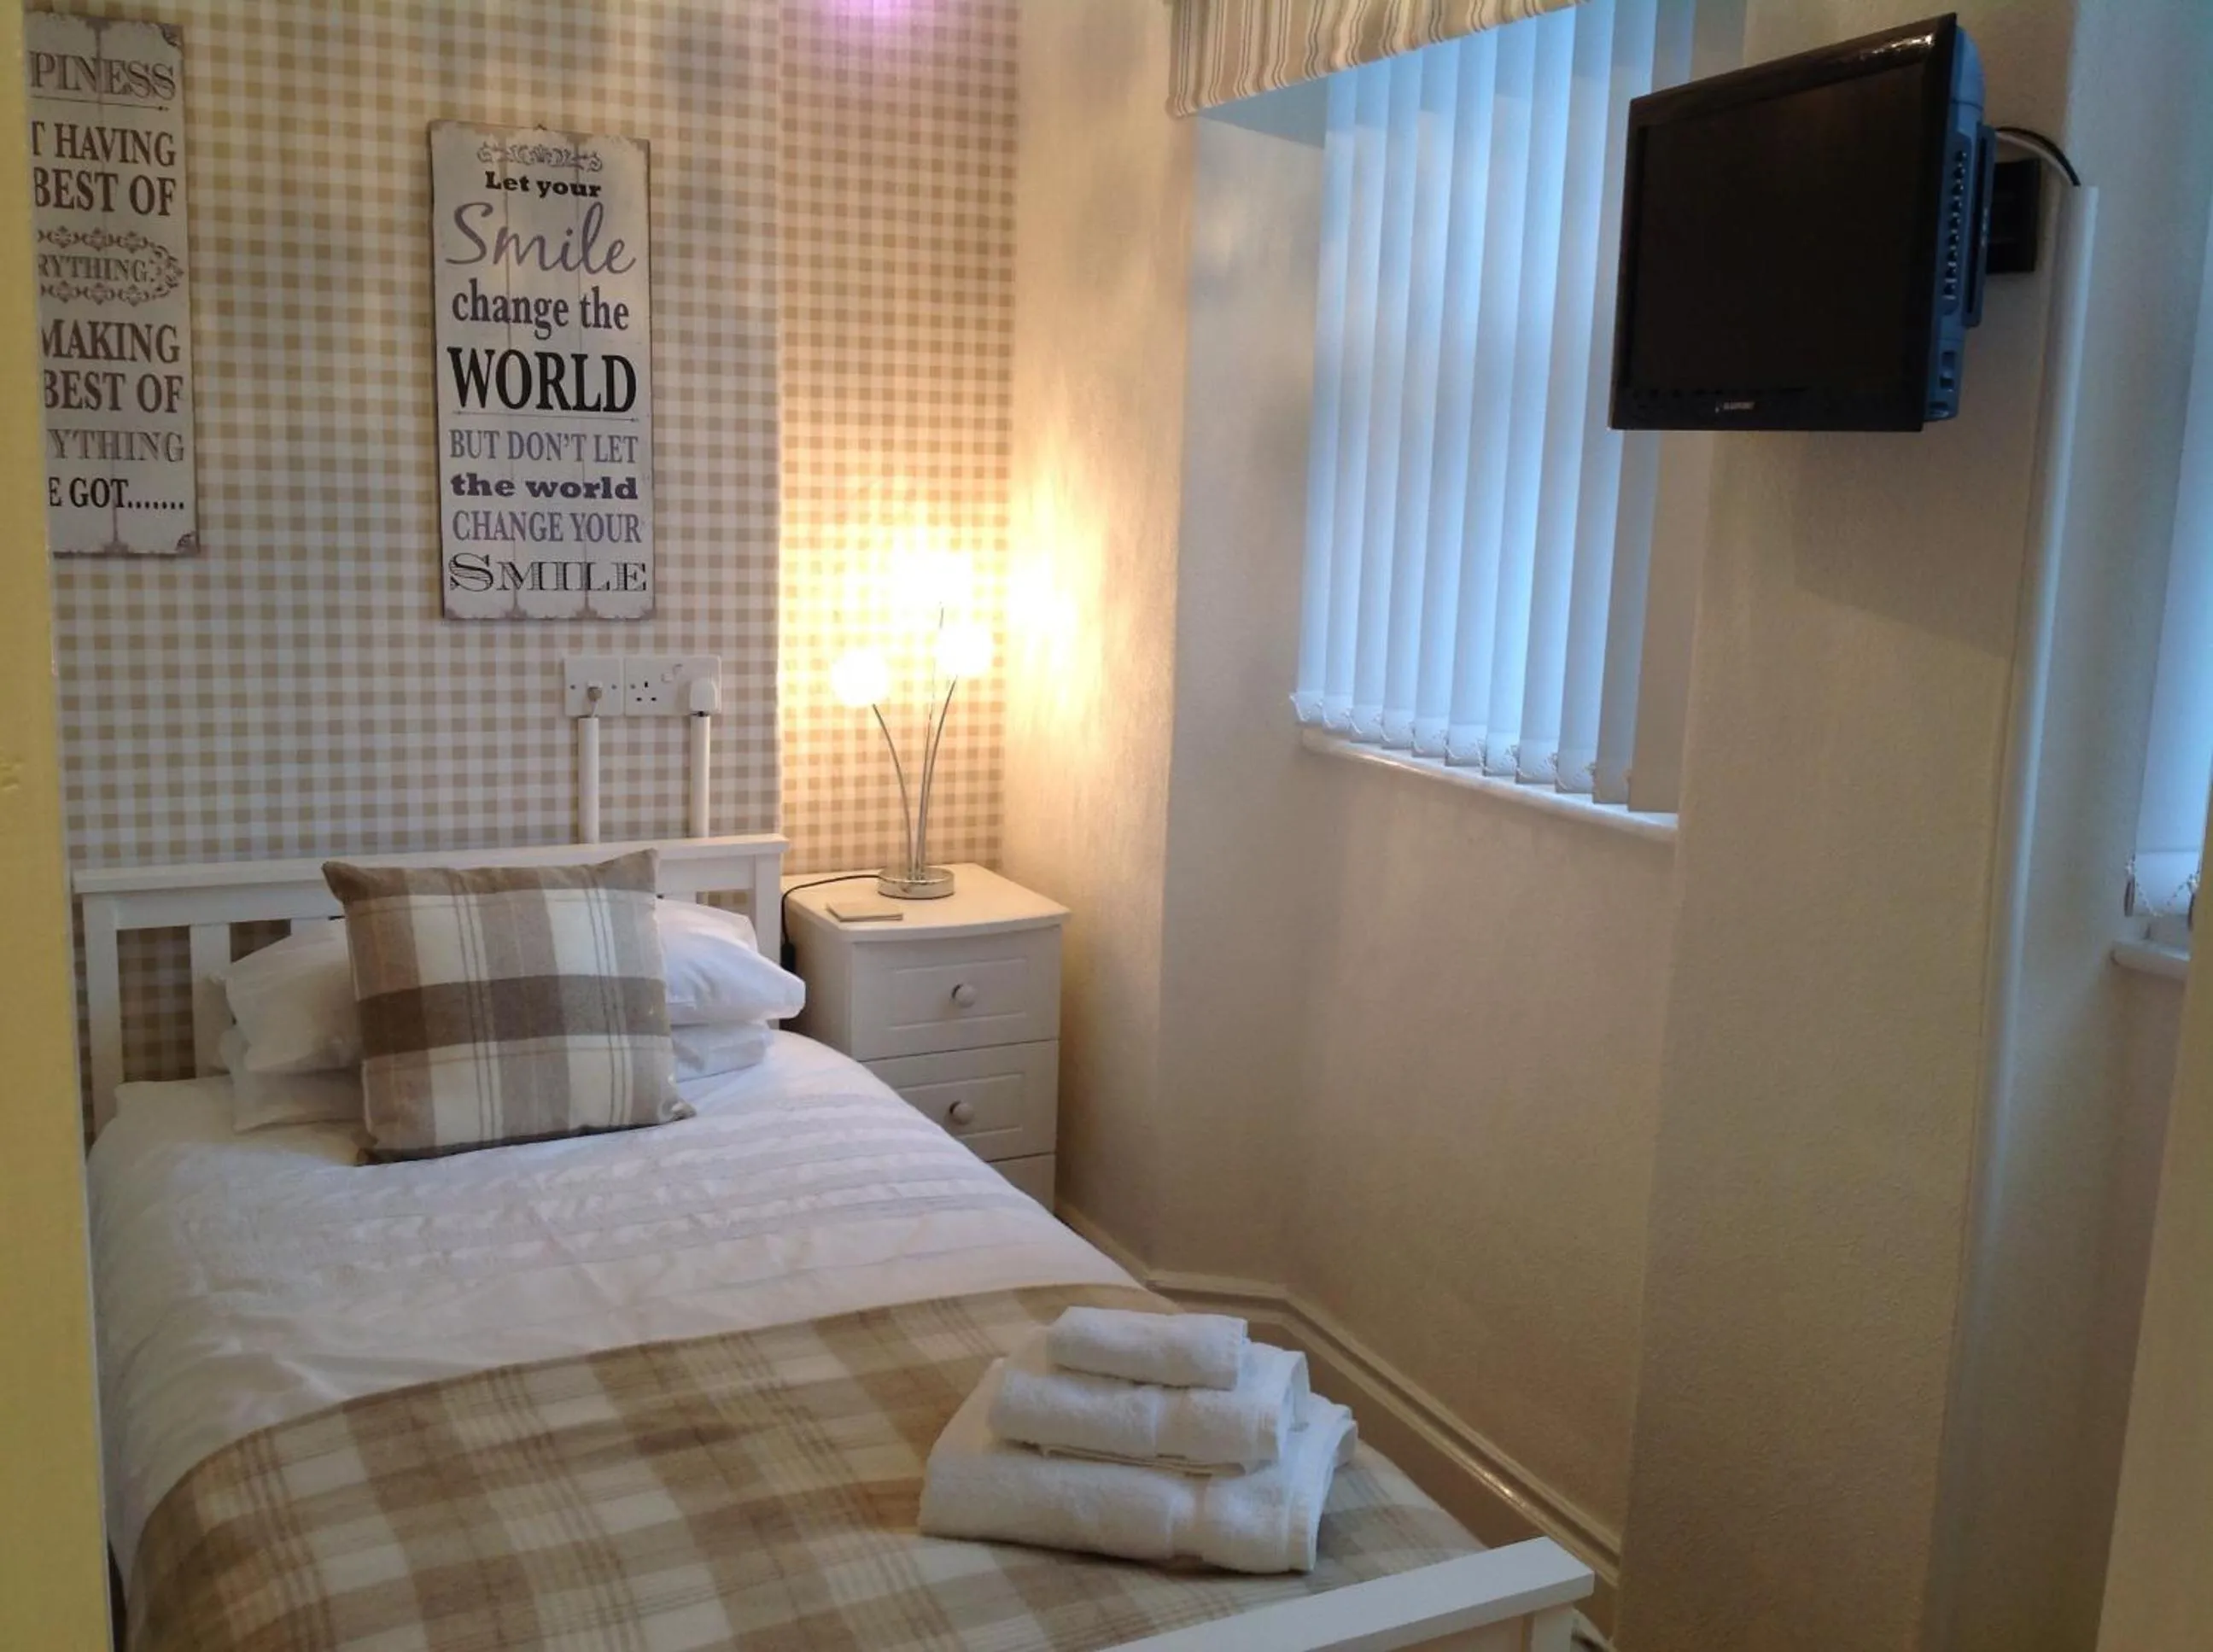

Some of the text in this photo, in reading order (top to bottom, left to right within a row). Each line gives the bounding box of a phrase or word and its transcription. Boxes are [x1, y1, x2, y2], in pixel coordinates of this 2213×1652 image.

[54, 122, 176, 167] HAVING
[33, 166, 176, 216] BEST OF
[485, 171, 602, 198] Let your
[445, 201, 636, 275] Smile
[452, 277, 629, 340] change the
[137, 373, 184, 413] OF
[447, 346, 637, 412] WORLD
[449, 429, 639, 464] BUT DON'T LET
[450, 472, 639, 499] the world
[452, 510, 642, 543] CHANGE YOUR
[448, 552, 646, 593] SMILE
